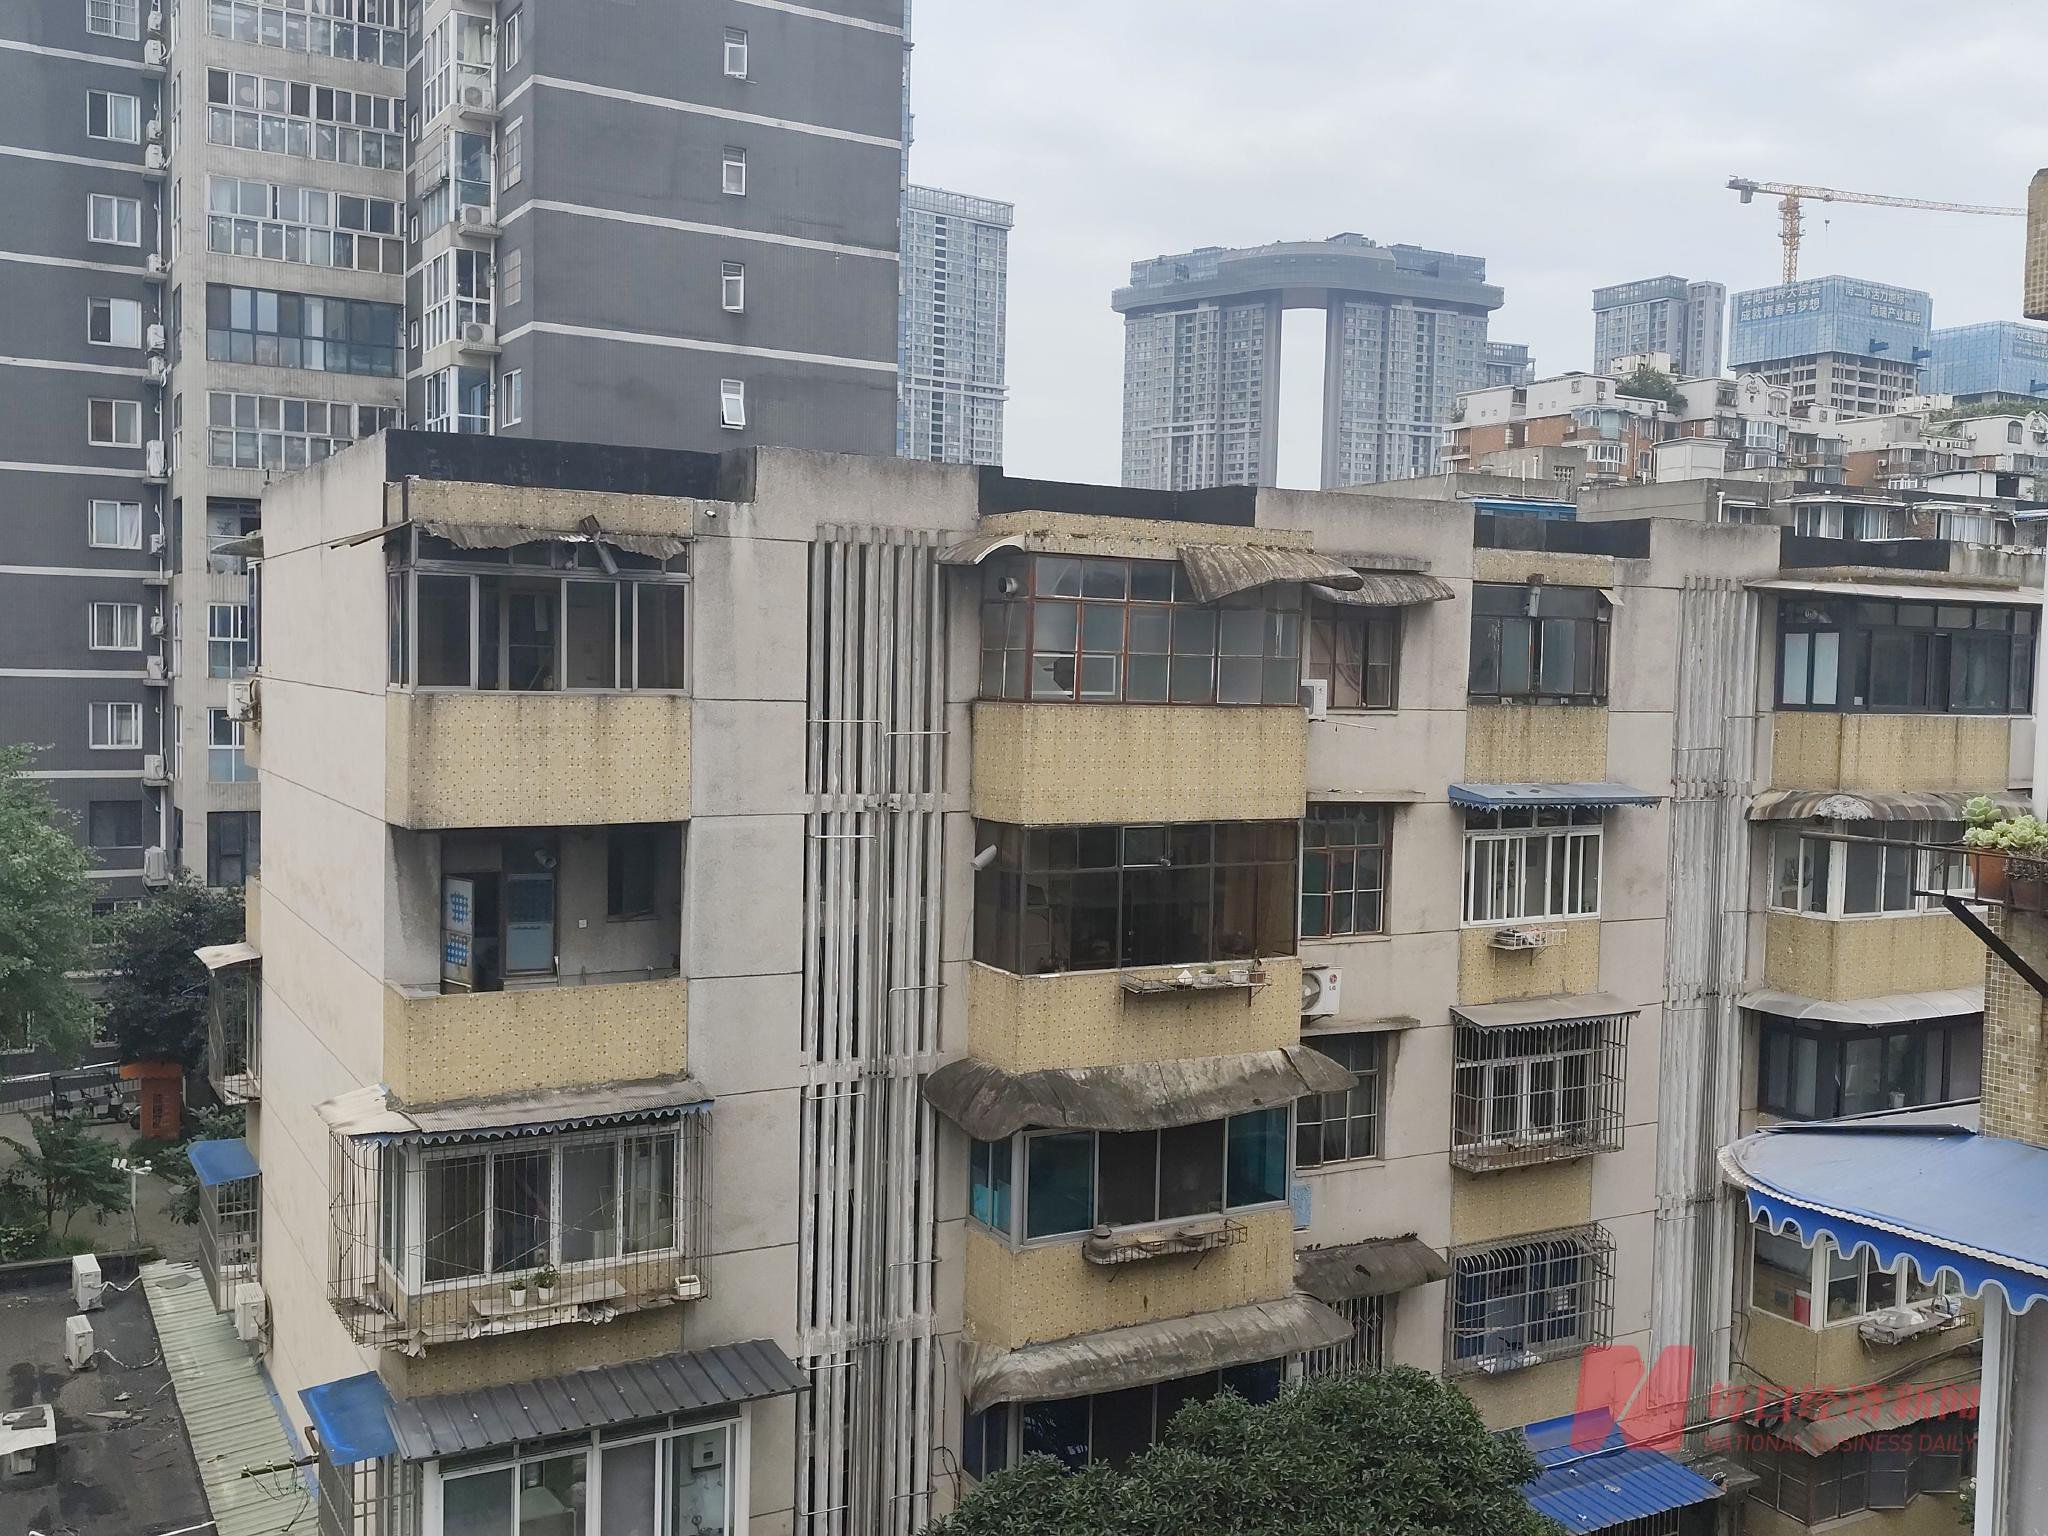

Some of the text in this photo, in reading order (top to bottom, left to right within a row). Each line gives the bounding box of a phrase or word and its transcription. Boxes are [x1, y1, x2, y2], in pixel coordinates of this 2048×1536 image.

[1741, 297, 1820, 321] 成就青春与梦想
